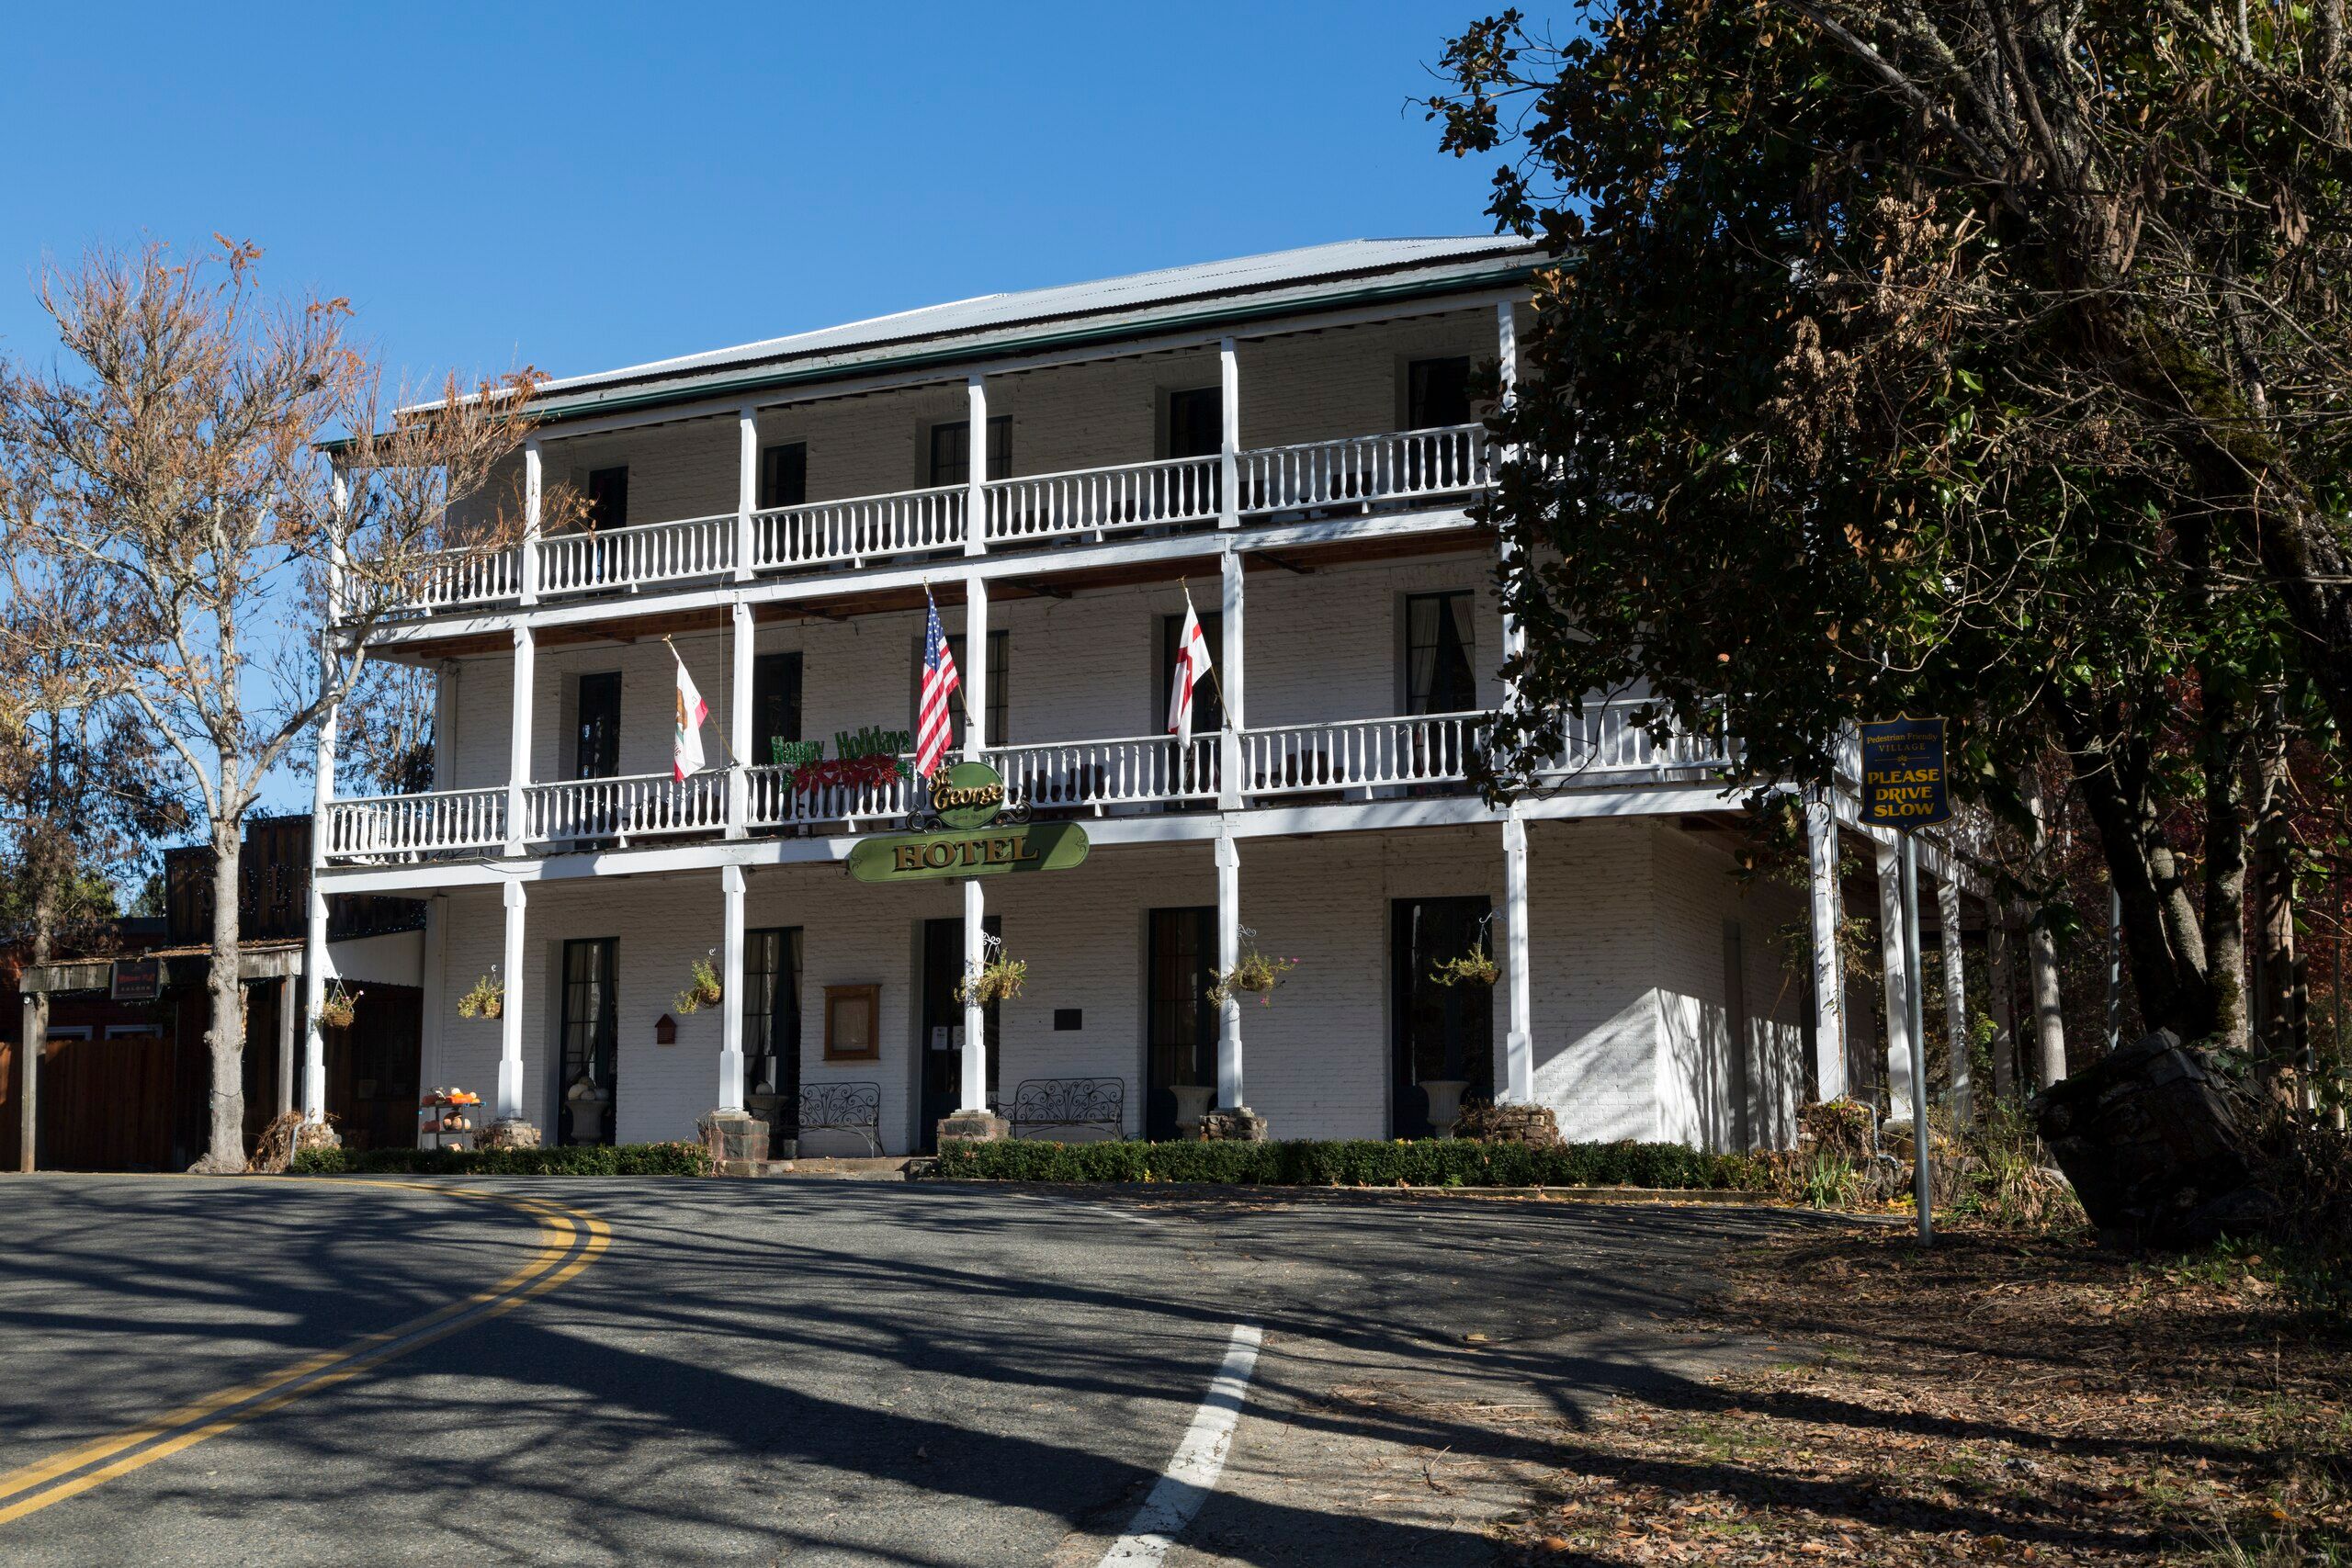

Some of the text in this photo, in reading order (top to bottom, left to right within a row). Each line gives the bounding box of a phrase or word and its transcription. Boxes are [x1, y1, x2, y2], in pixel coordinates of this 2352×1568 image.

[771, 725, 911, 767] Happy Holidays
[1867, 732, 1939, 744] Pedestrian Friendly
[1878, 742, 1927, 752] VILLAGE
[928, 765, 954, 792] St.
[1867, 768, 1940, 784] PLEASE
[933, 783, 1005, 810] George
[1875, 785, 1933, 804] DRIVE
[1873, 802, 1935, 818] SLOW
[892, 835, 1040, 873] HOTEL
